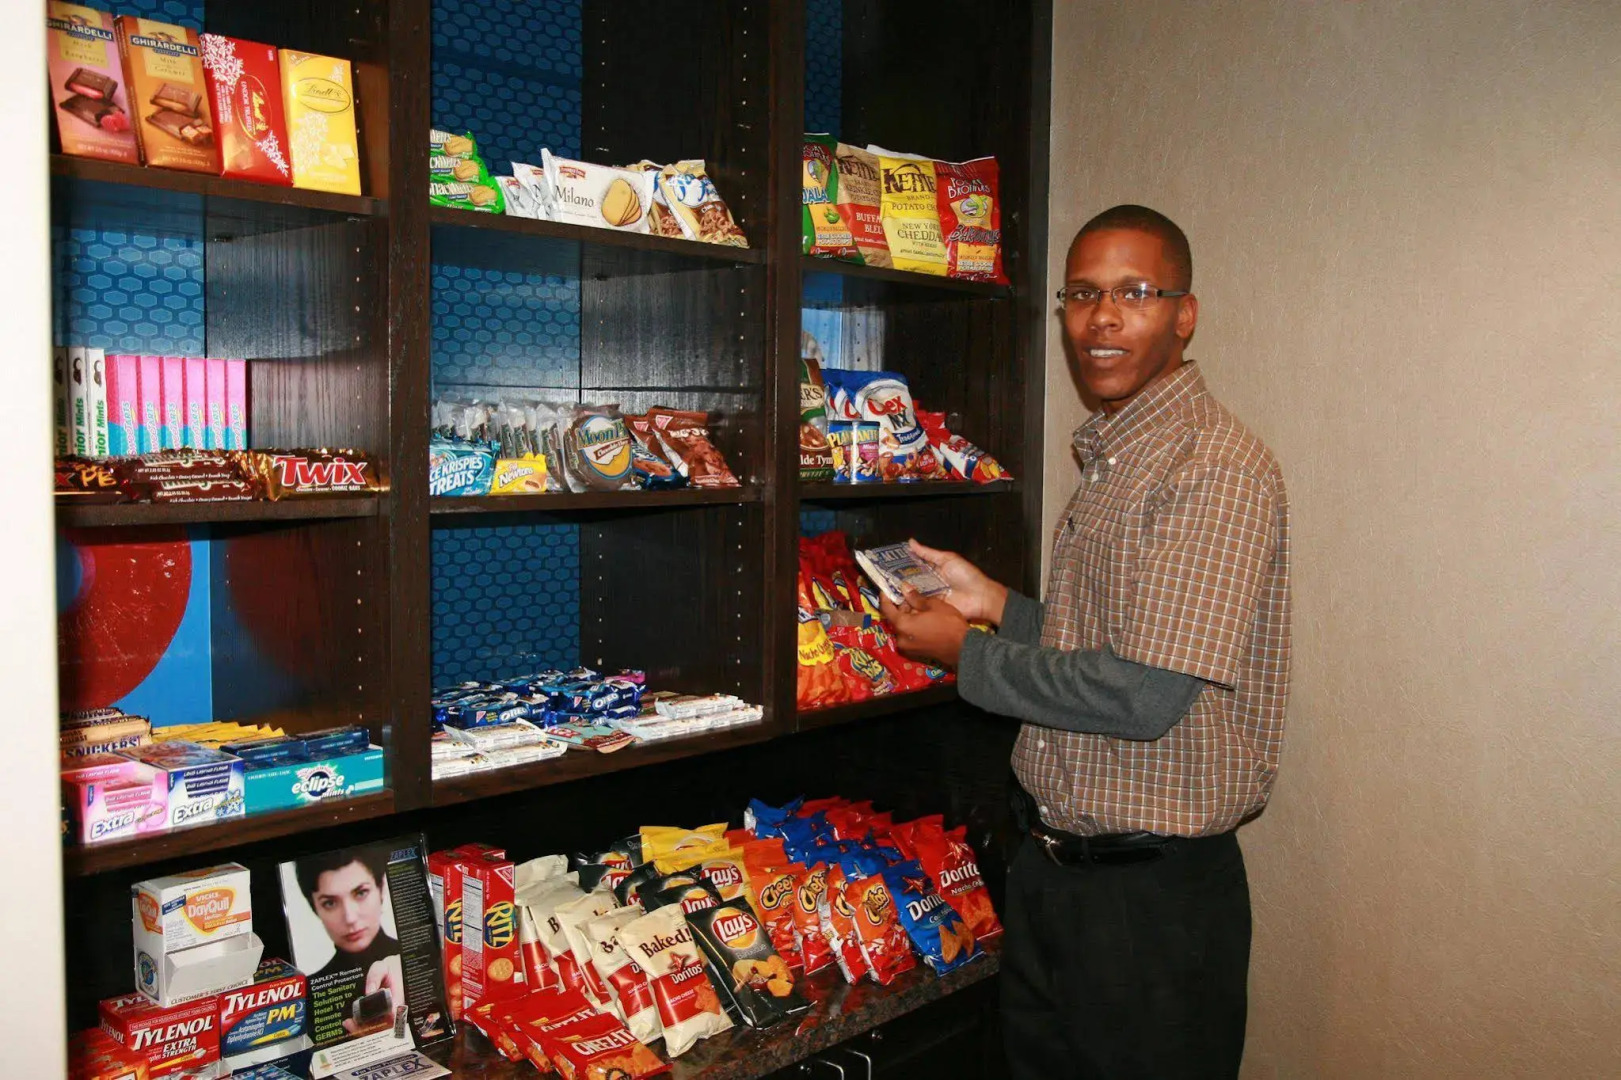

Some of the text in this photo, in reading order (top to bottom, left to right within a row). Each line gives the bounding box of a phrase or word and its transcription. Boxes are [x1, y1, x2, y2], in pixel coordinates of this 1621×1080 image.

[132, 37, 197, 56] GHIRARDELLI
[880, 164, 937, 194] KETTLE
[555, 185, 595, 208] Milano
[892, 203, 925, 211] POTATO
[96, 399, 105, 428] Mints
[271, 454, 368, 487] Twix
[441, 456, 483, 477] KRISPIES
[430, 470, 475, 496] TREATS
[498, 467, 534, 489] Newtons
[66, 739, 137, 758] SNICKERS
[291, 774, 345, 796] eclipse
[173, 797, 214, 825] Extra
[91, 810, 135, 840] Extra
[187, 896, 230, 919] DayQuil
[716, 912, 753, 943] Lay's
[638, 928, 694, 959] Baked!
[311, 973, 364, 992] Control Protectors
[339, 967, 363, 977] Remote
[669, 963, 703, 985] Doritos
[222, 981, 303, 1020] TYLENOL
[313, 982, 357, 999] The Sanitary
[313, 995, 343, 1008] Solution
[265, 1003, 297, 1025] PM
[314, 1001, 346, 1016] Hotel TV
[314, 1012, 342, 1024] Remote
[100, 1018, 125, 1044] TYLENOL
[130, 1015, 214, 1052] TYLENOL
[315, 1019, 342, 1032] Control
[315, 1027, 344, 1041] GERMS
[161, 1044, 197, 1059] STRENGTH
[163, 1036, 197, 1053] EXTRA
[571, 1028, 636, 1056] CHEEZ-IT
